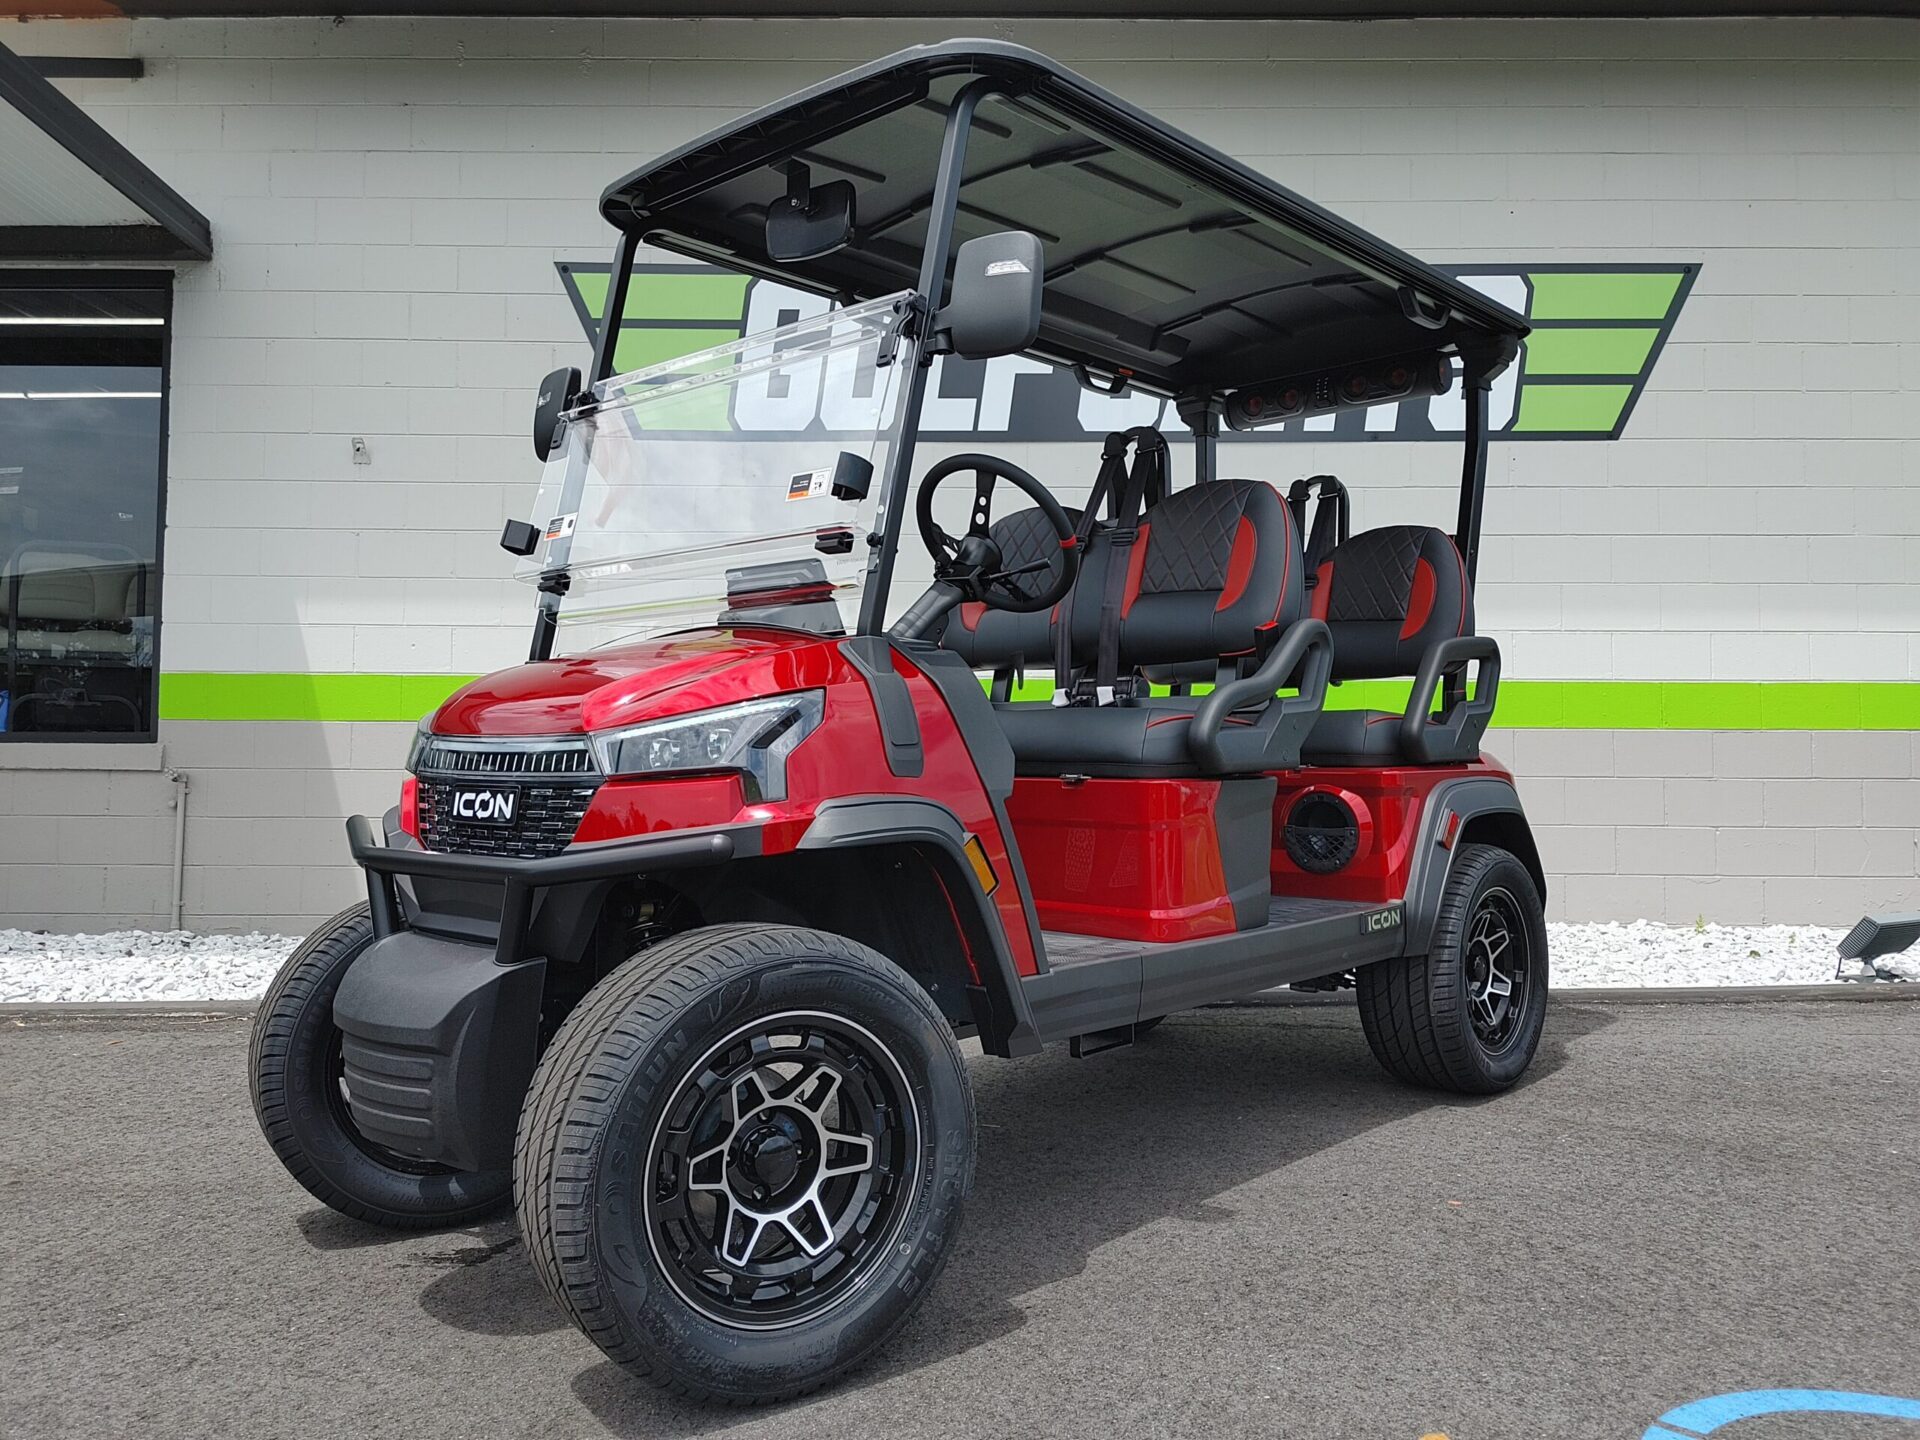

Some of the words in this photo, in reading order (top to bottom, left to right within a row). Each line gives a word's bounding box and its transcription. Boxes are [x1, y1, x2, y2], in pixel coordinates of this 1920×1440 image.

[452, 789, 515, 820] ICON
[1367, 908, 1402, 933] ICON
[609, 1029, 689, 1172] SAILUN
